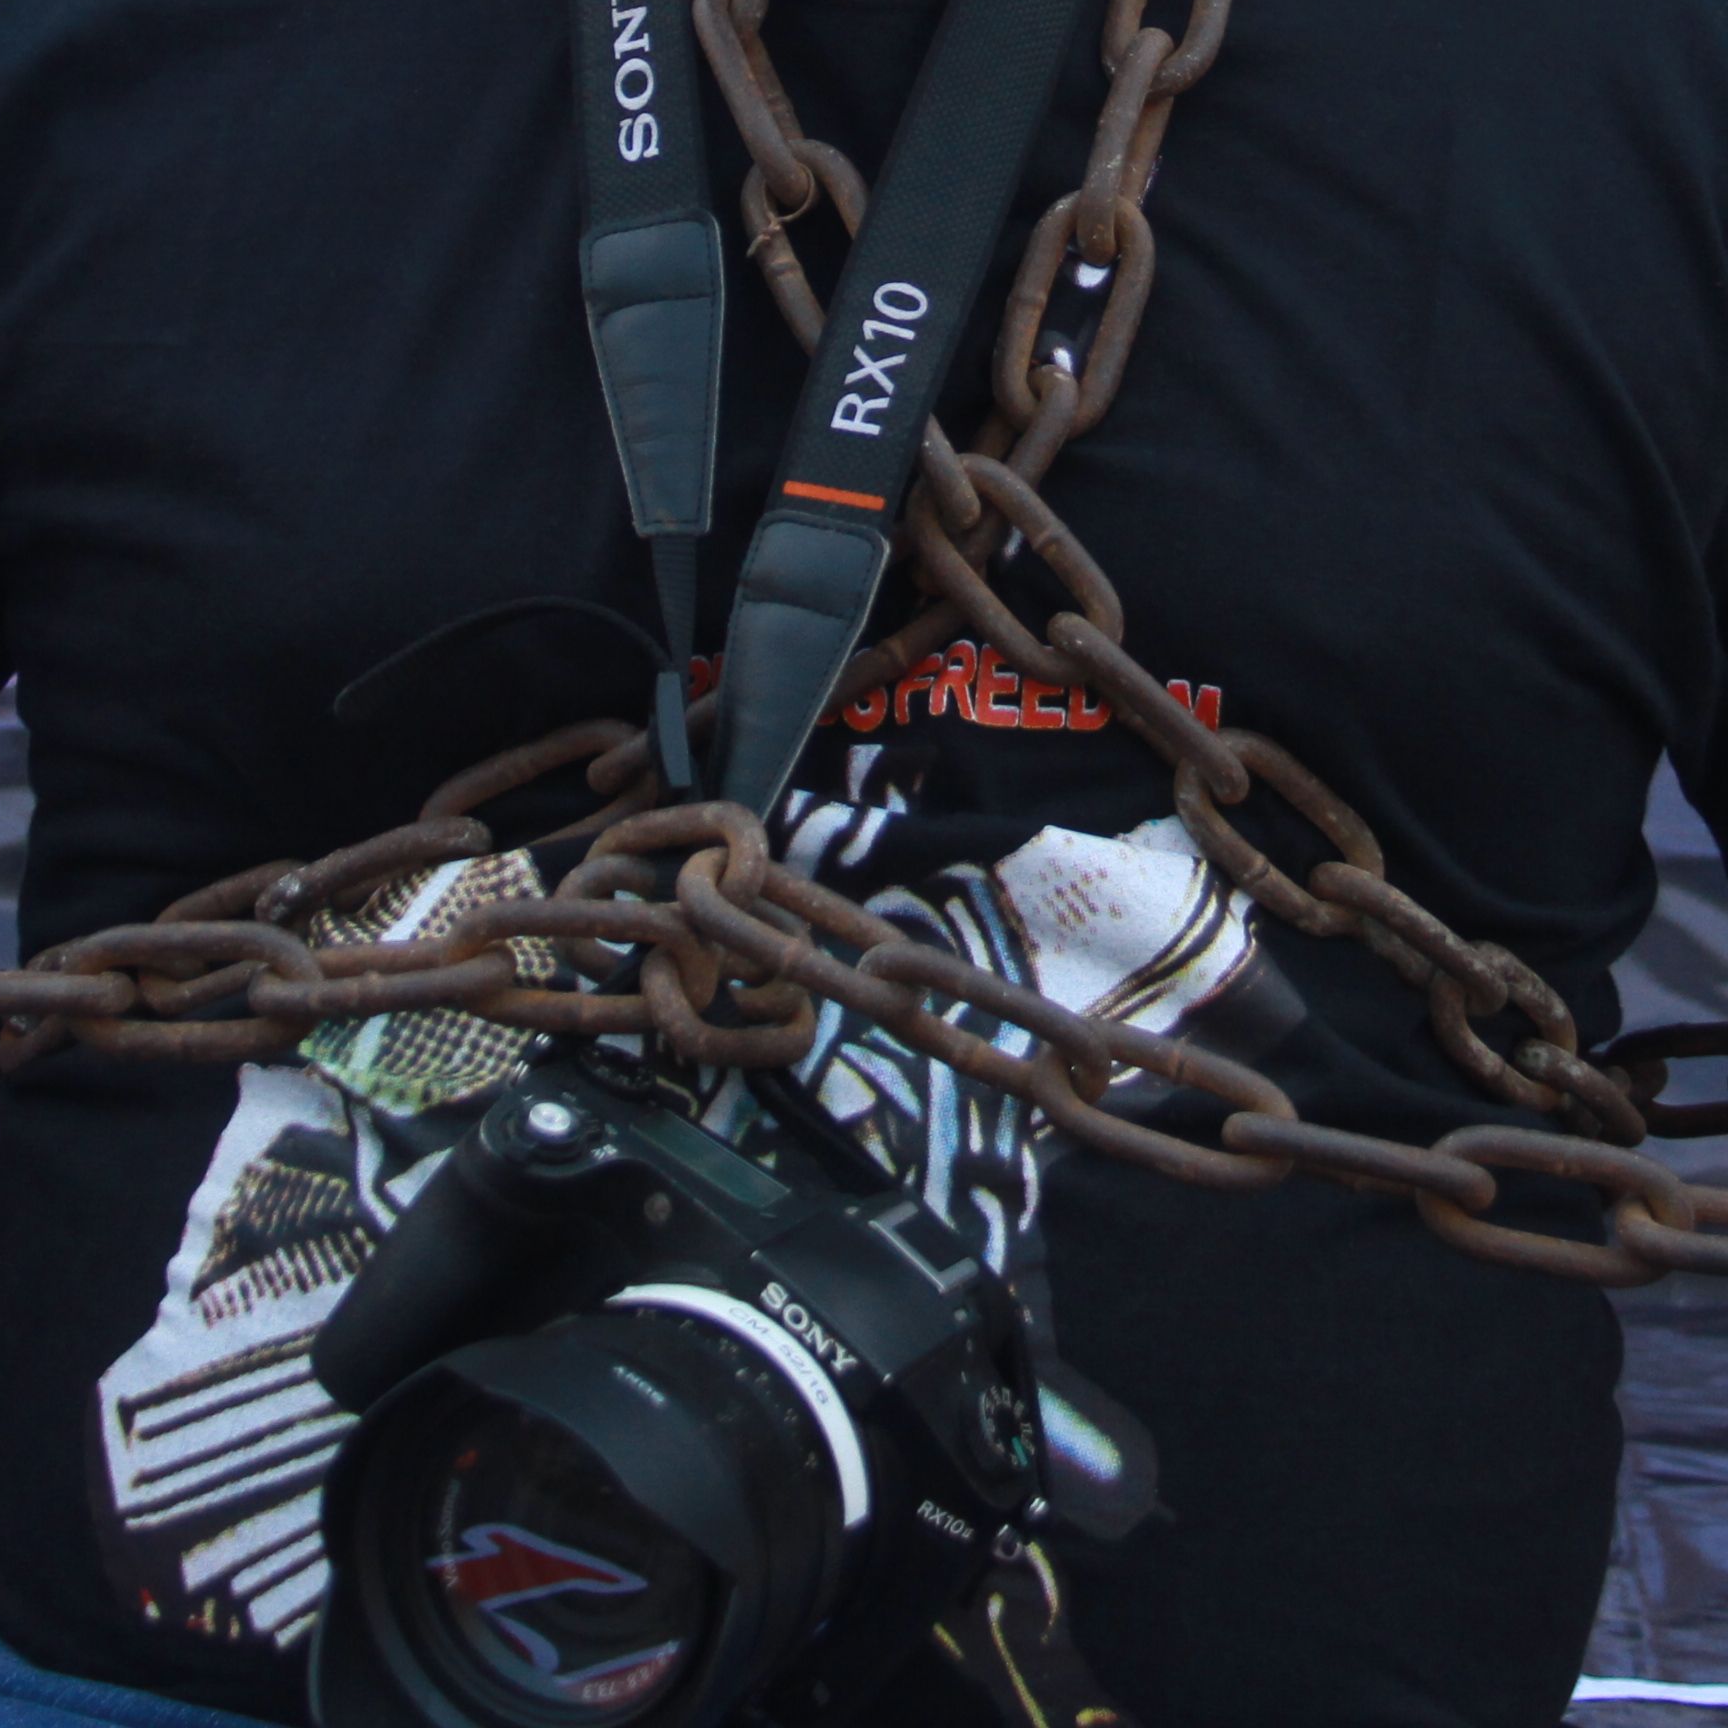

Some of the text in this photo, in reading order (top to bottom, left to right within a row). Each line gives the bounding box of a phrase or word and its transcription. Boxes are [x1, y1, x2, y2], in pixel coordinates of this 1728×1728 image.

[829, 281, 929, 436] RX10
[894, 638, 1223, 732] FREEDM
[759, 1281, 859, 1372] SONY
